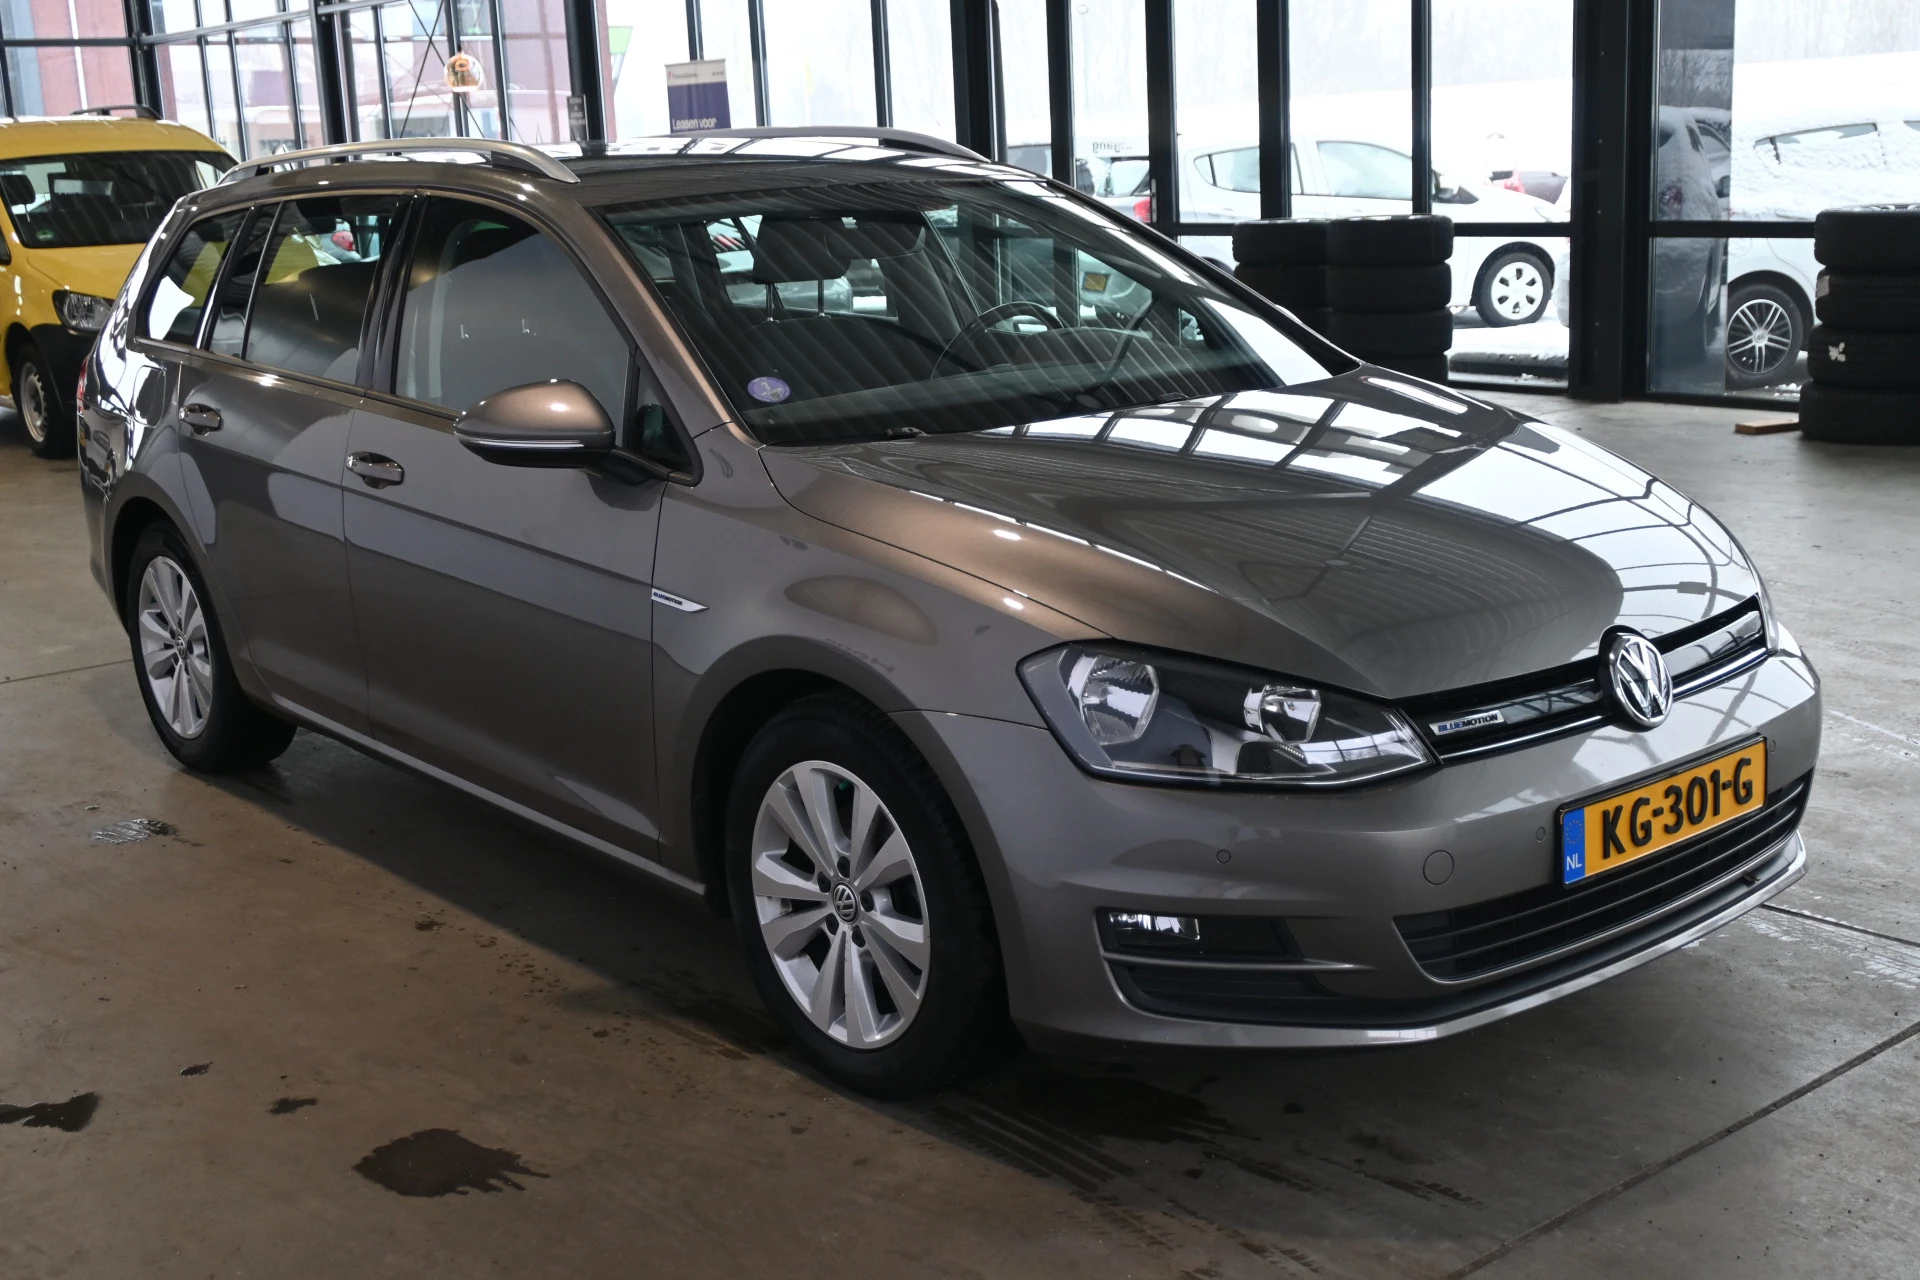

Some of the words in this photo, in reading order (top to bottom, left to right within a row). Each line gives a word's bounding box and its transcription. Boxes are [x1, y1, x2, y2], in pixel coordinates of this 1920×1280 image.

[672, 117, 699, 130] Leasen
[699, 117, 717, 129] voor
[1438, 713, 1498, 732] BLUEMOTION
[1602, 757, 1753, 860] KG-301-G
[1566, 854, 1583, 871] NL
